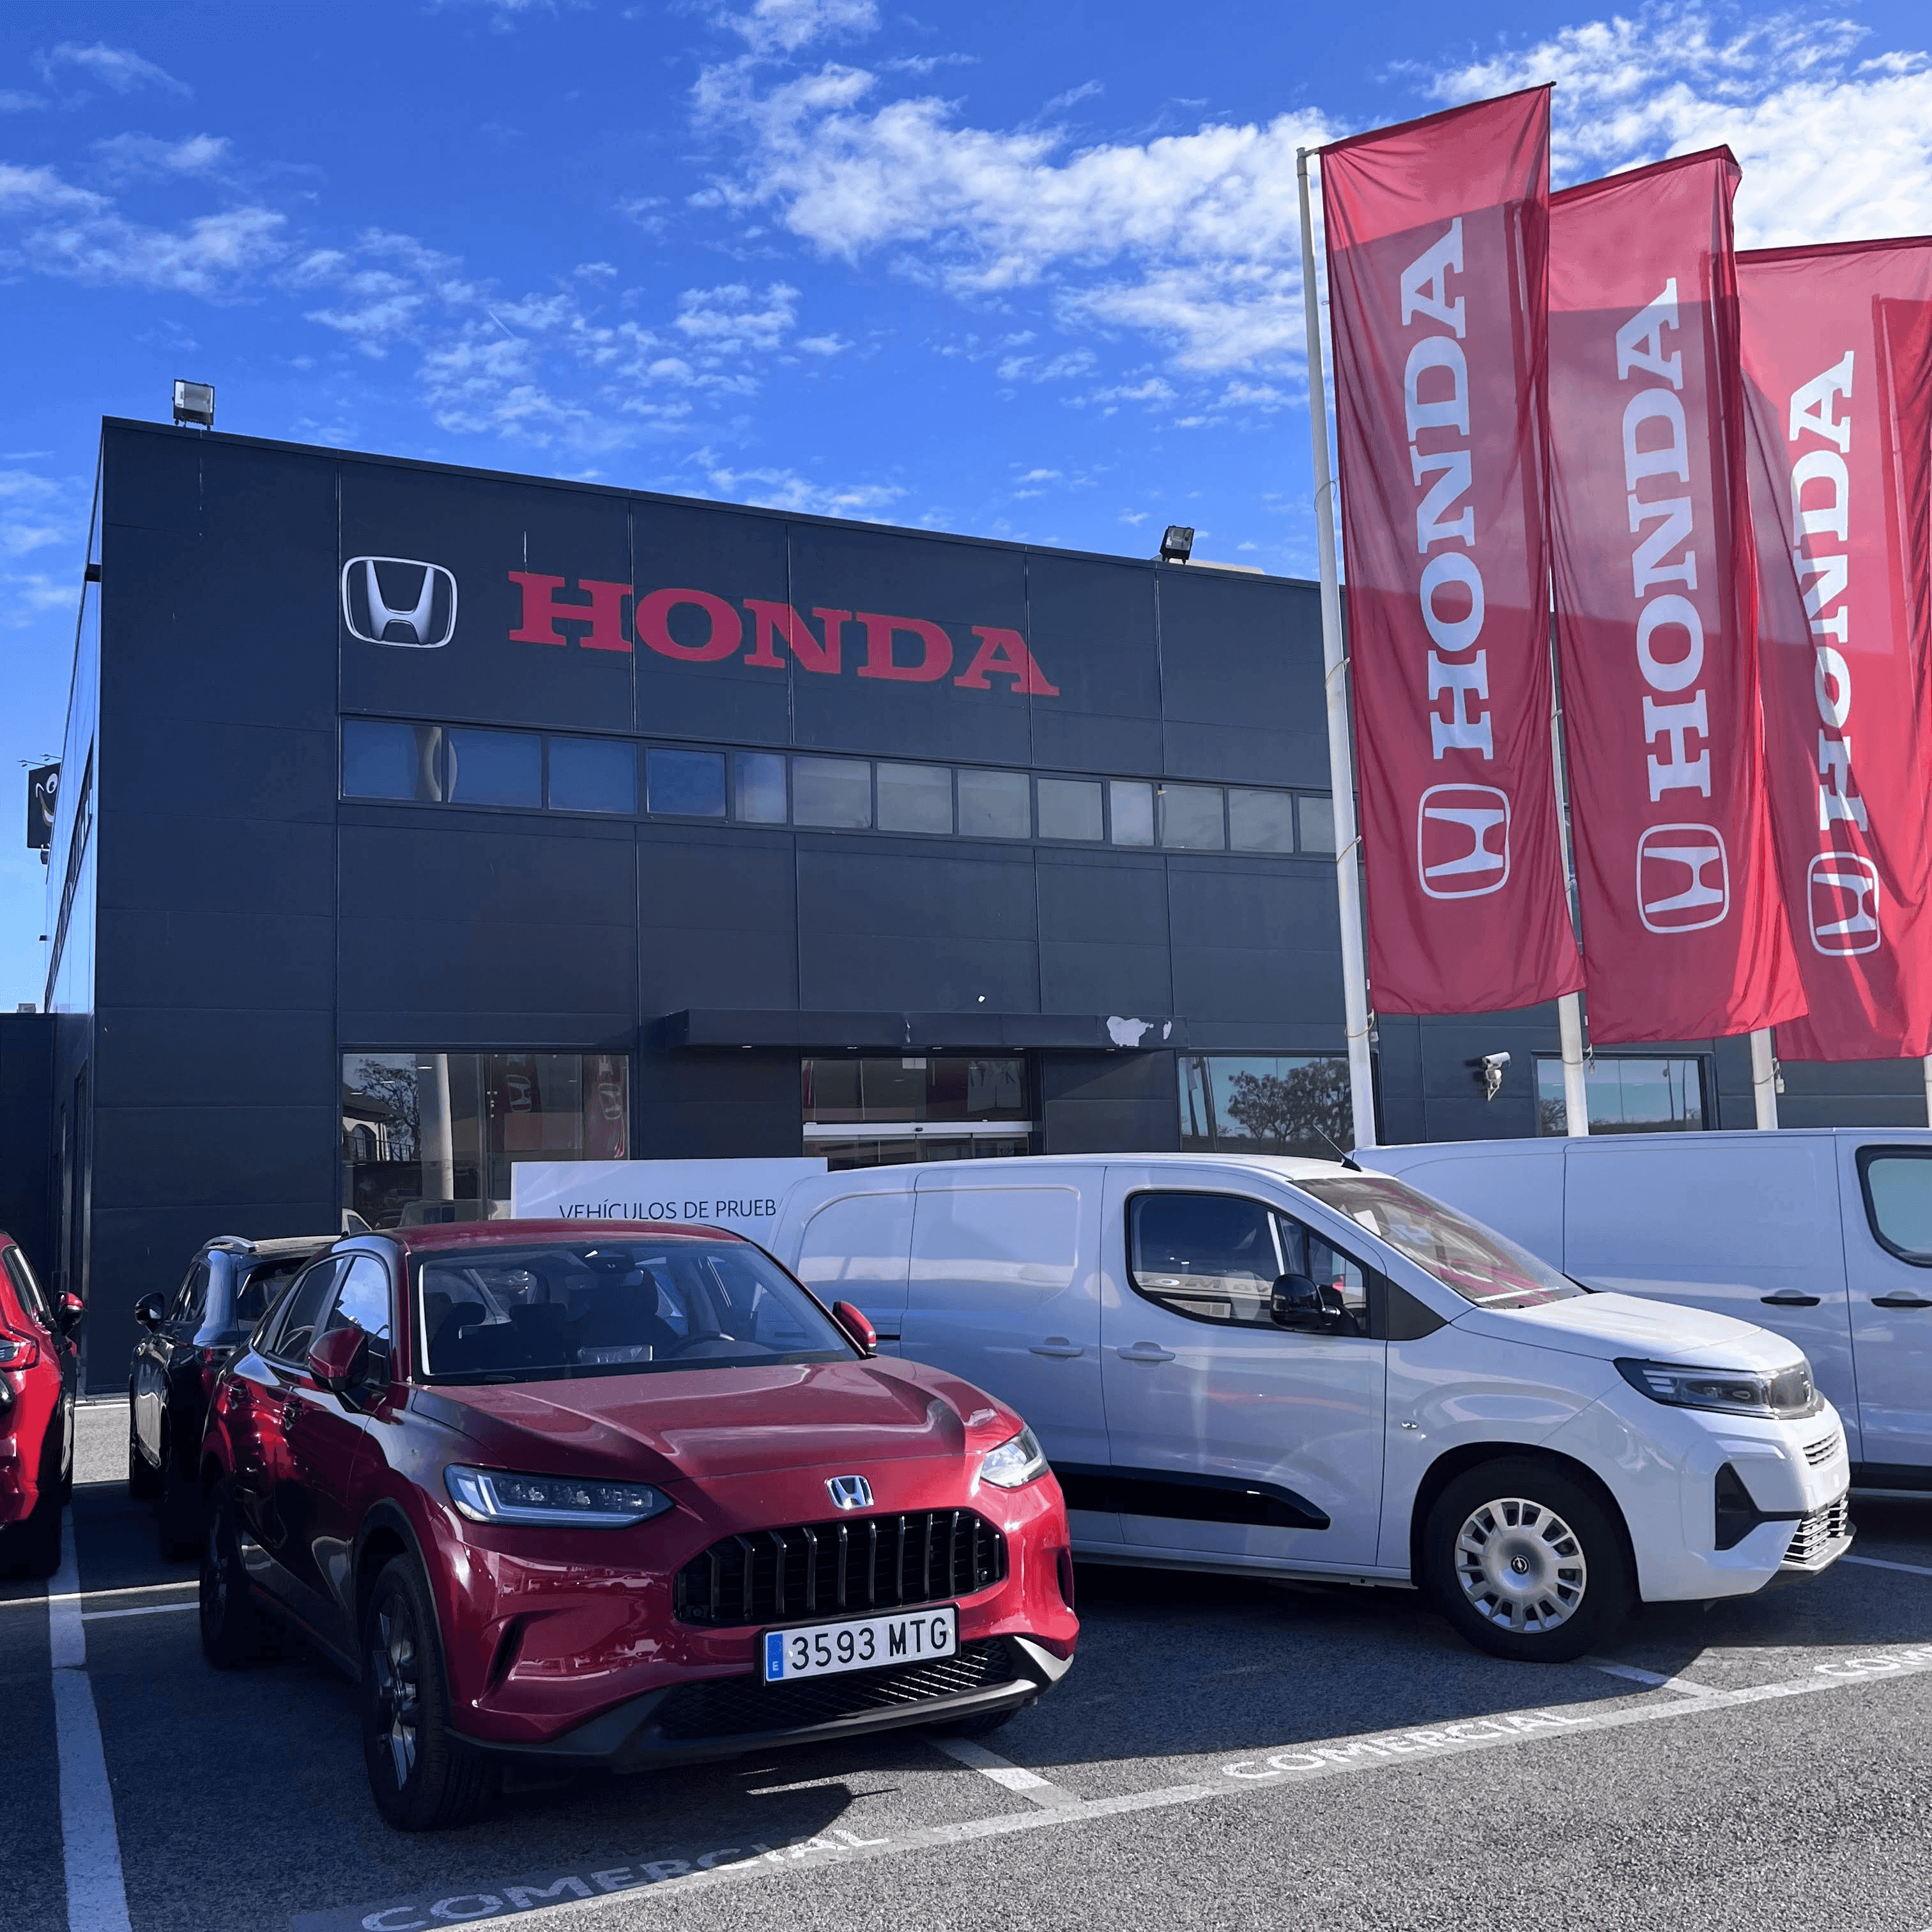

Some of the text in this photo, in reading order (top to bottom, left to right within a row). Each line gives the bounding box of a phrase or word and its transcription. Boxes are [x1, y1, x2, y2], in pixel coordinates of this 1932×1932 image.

[1400, 217, 1494, 760] HONDA
[1616, 277, 1711, 802] HONDA
[508, 570, 1061, 697] HONDA
[1788, 350, 1868, 833] HONDA
[559, 1199, 677, 1220] VEHÍCULOS
[684, 1200, 710, 1219] DE
[772, 1660, 779, 1672] E
[791, 1616, 947, 1671] 3593 MTG
[1222, 1711, 1594, 1779] COMERCIAL
[361, 1829, 890, 1932] COMERCIAL
